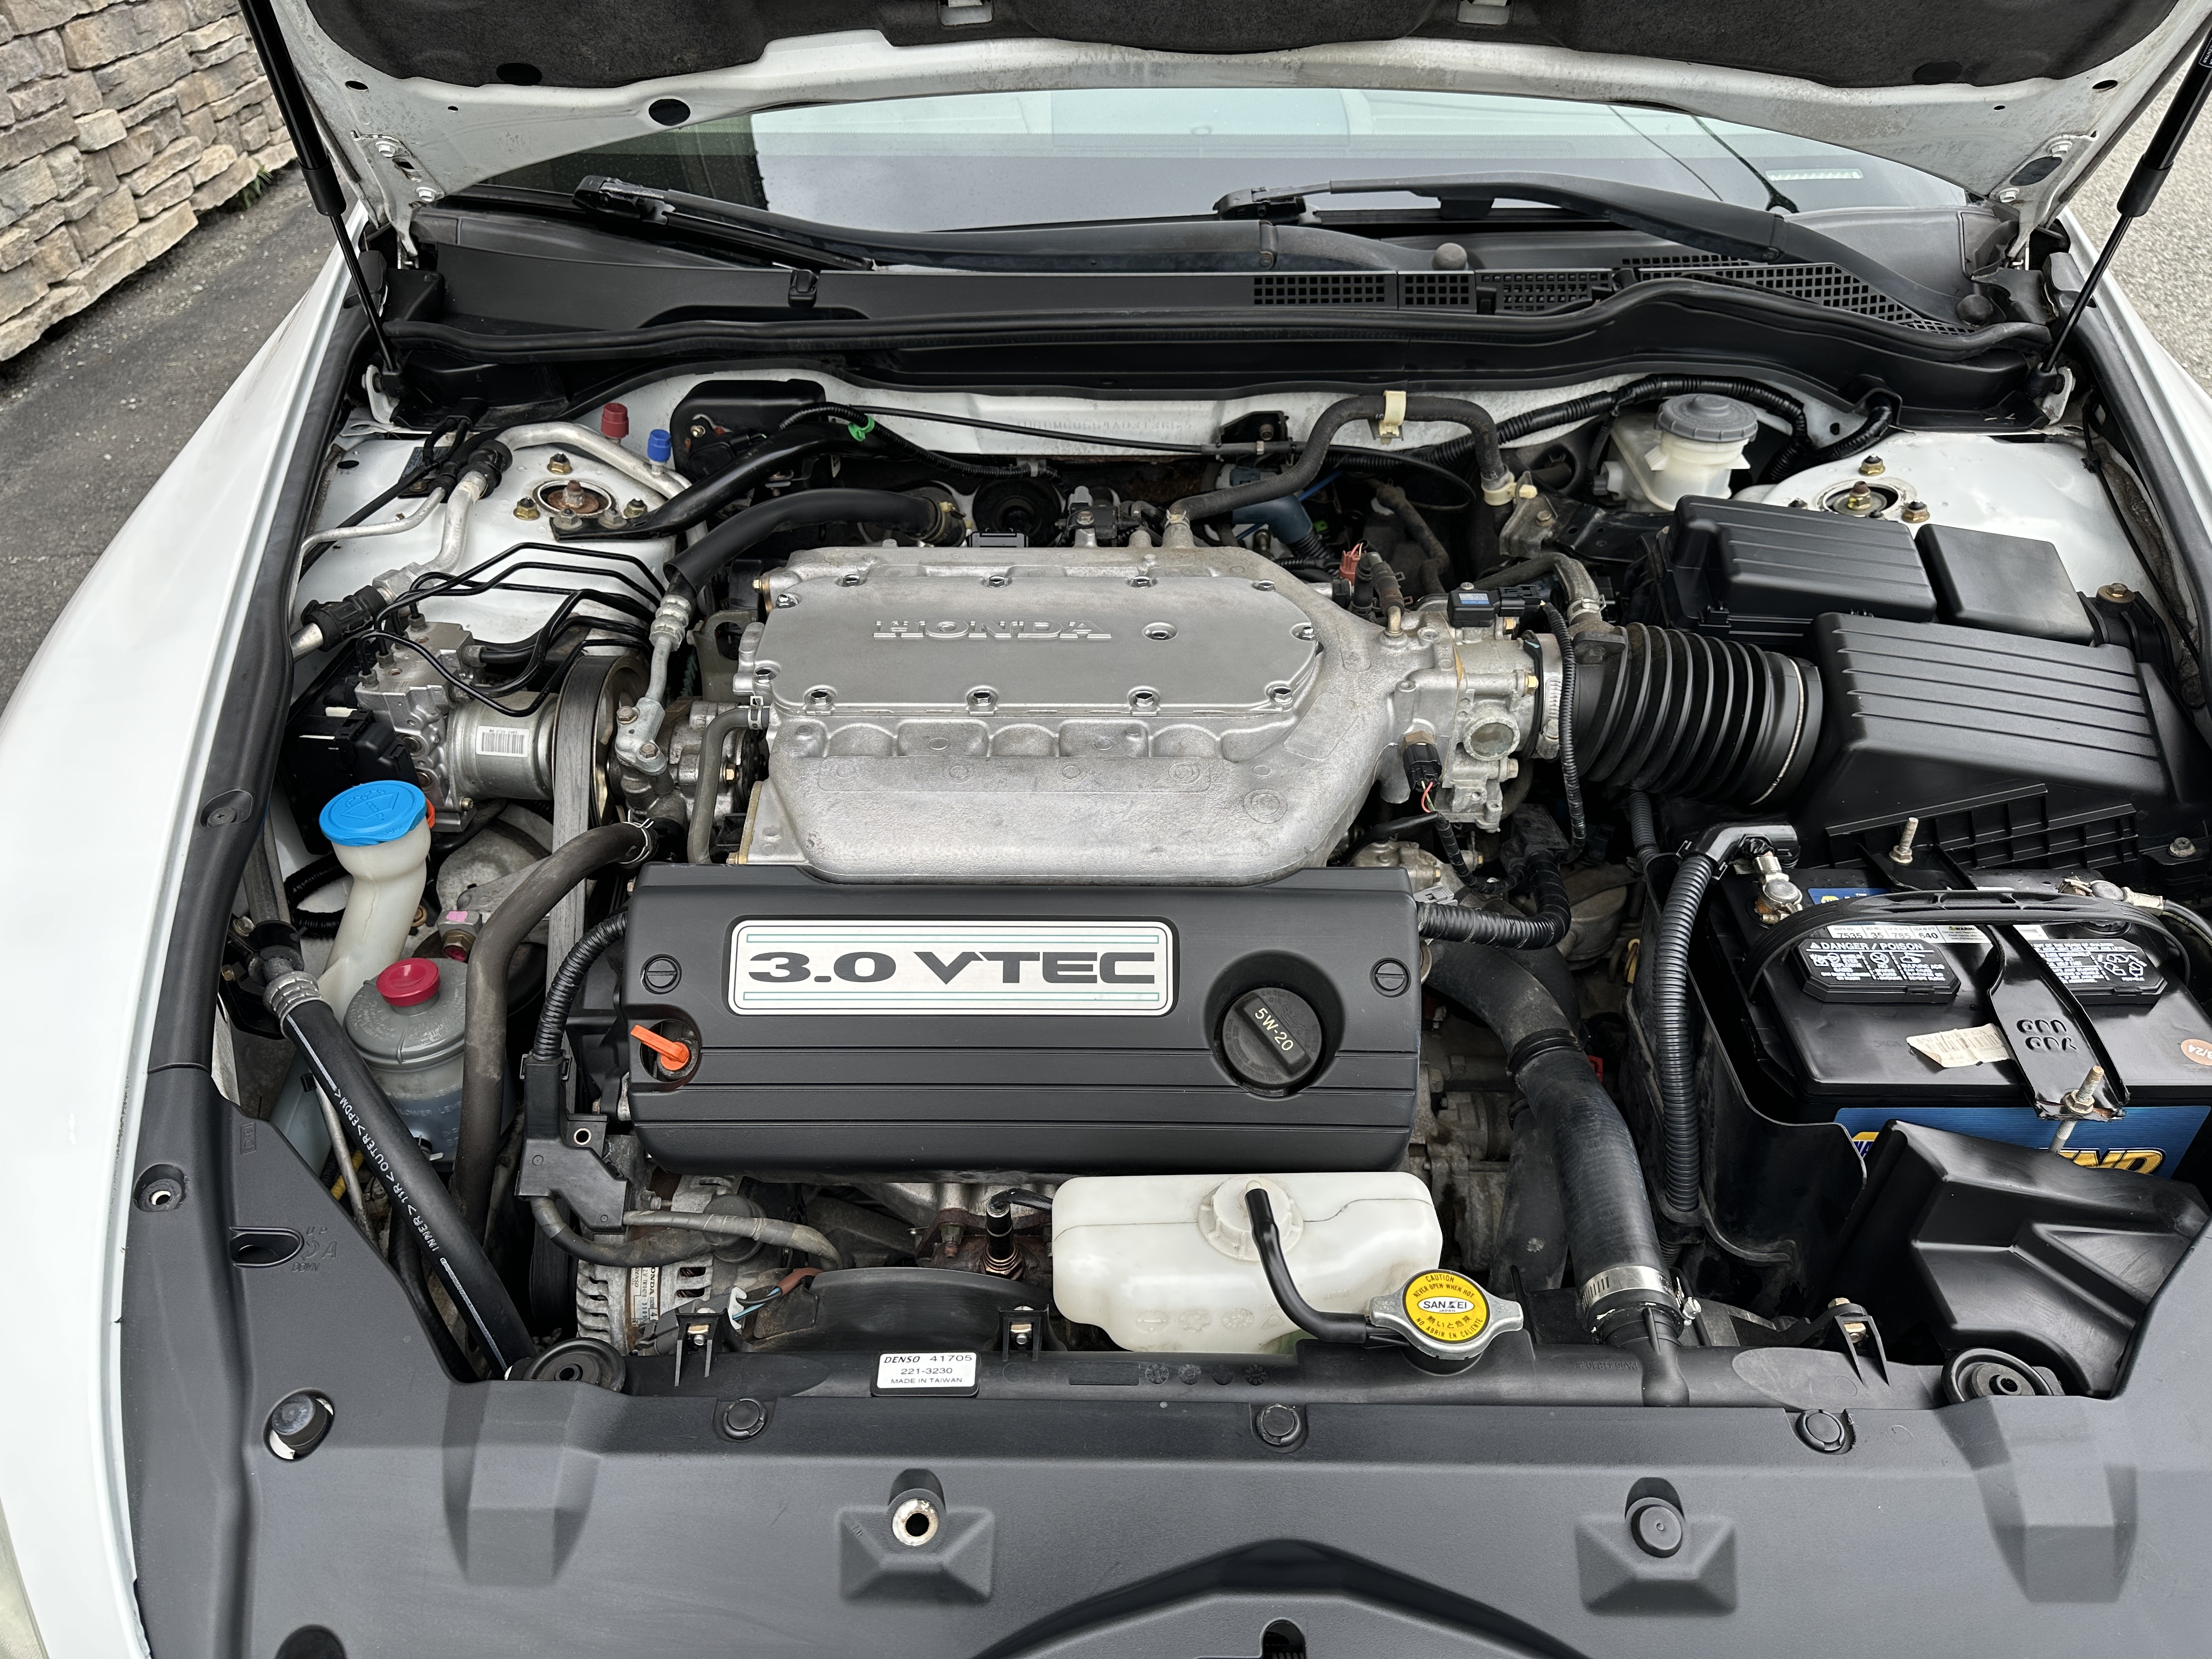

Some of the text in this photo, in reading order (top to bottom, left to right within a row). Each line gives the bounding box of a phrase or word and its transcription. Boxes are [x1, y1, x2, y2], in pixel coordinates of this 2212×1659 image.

[873, 620, 1111, 638] HONDA
[749, 950, 1155, 985] 3.0 VTEC
[1255, 1007, 1294, 1051] 5W-20
[398, 1101, 462, 1116] LOWER LEVE
[413, 1215, 439, 1251] INNER
[1425, 1274, 1454, 1283] CAUTION
[1413, 1284, 1429, 1298] NEVER
[1446, 1284, 1462, 1293] WHEN
[1463, 1289, 1475, 1298] HOT
[1423, 1300, 1467, 1309] SANKEI
[1415, 1317, 1424, 1326] NO
[1426, 1326, 1444, 1338] ABRIR
[1460, 1317, 1483, 1338] CALIENTE
